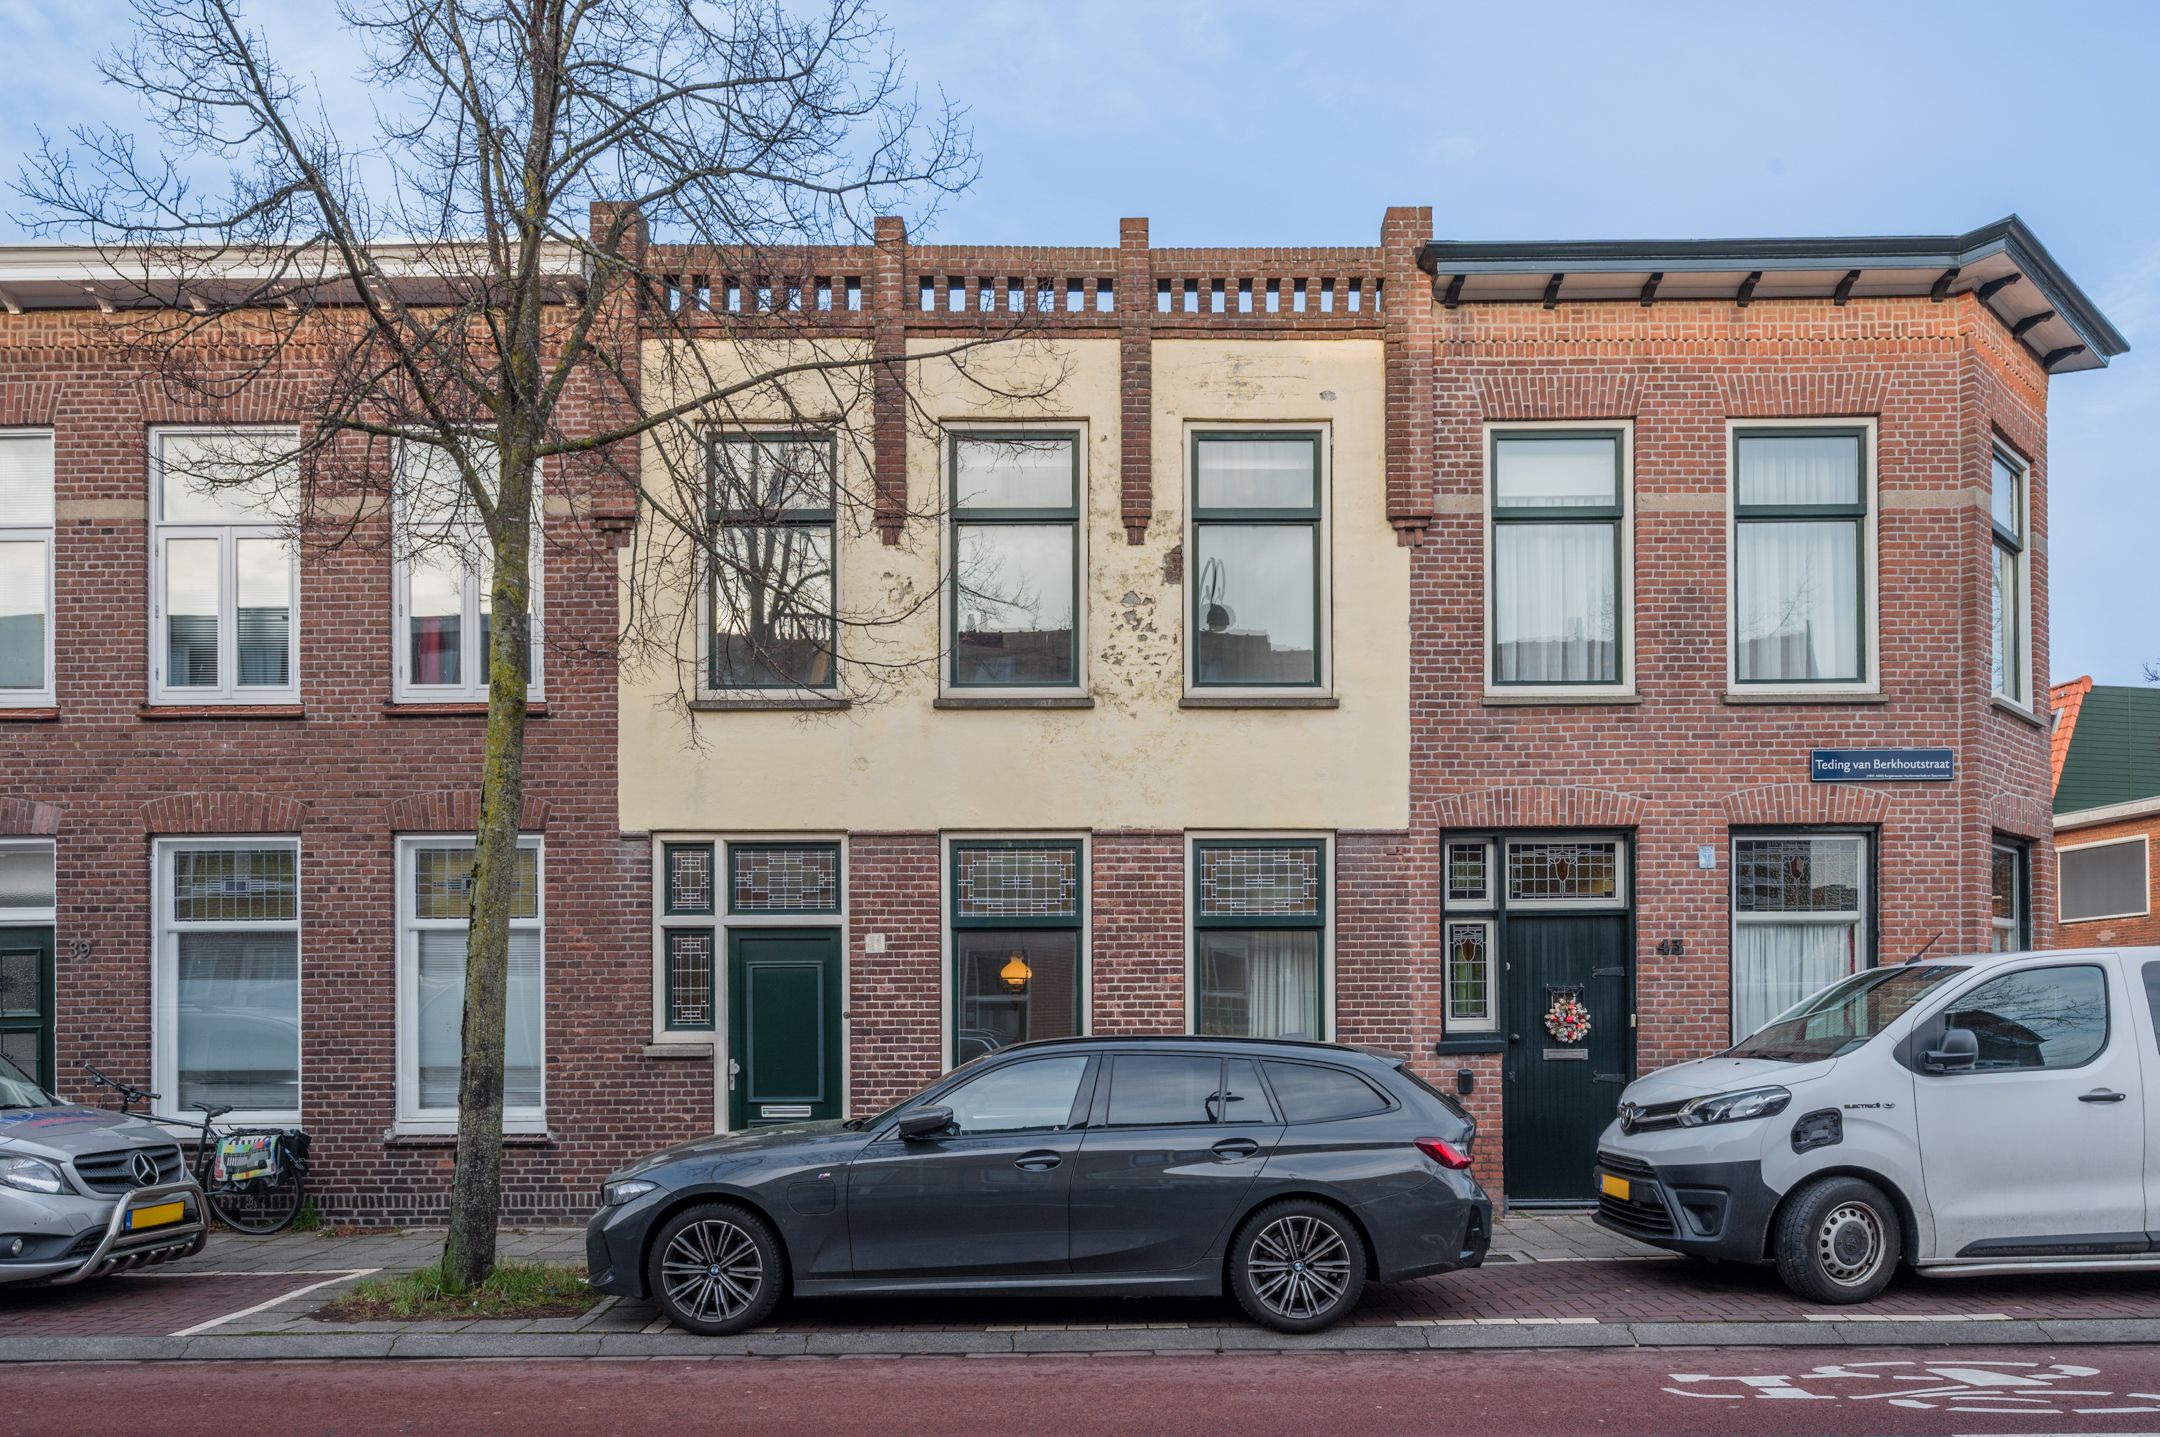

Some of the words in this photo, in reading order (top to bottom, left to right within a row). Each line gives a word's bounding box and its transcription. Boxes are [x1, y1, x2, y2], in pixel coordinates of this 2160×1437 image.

[1815, 759, 1850, 772] Teding
[1852, 761, 1871, 770] van
[1873, 758, 1950, 770] Berkhoutstraat
[68, 940, 91, 958] 39
[1656, 939, 1684, 955] 43
